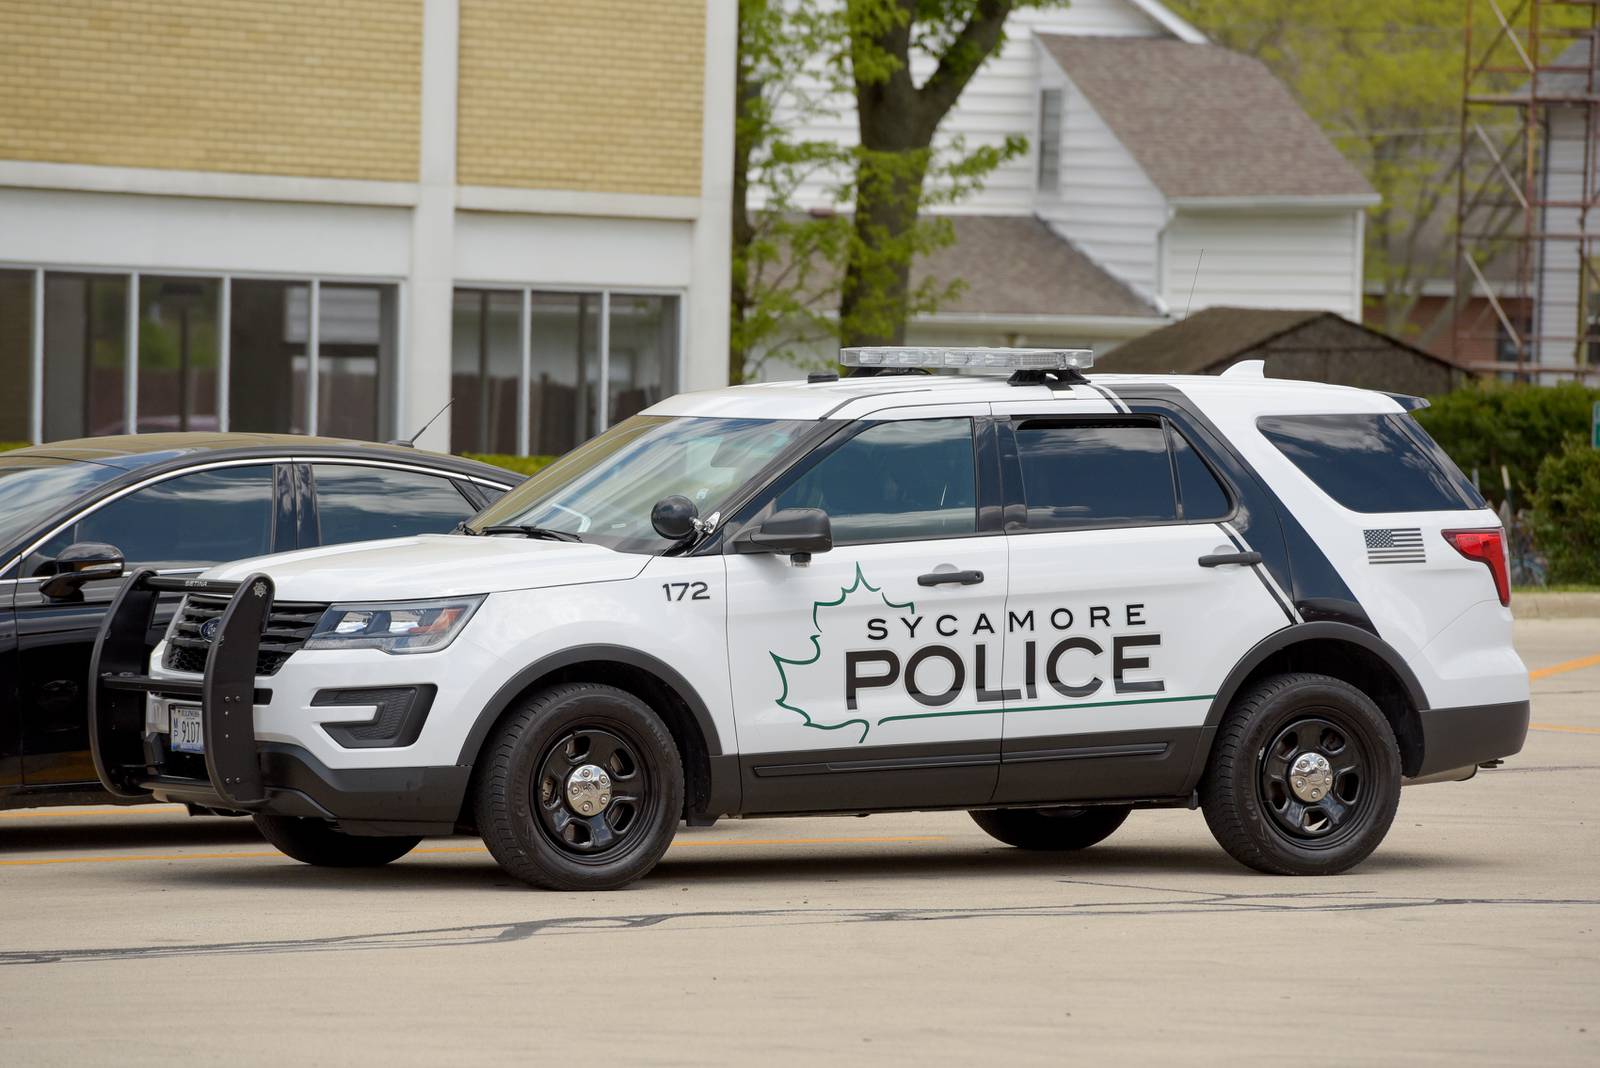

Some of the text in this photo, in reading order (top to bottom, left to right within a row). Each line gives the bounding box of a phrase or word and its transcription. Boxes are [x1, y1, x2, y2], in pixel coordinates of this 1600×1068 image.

[662, 581, 711, 602] 172
[867, 604, 1146, 641] SYCAMORE
[845, 634, 1165, 711] POLICE
[181, 720, 200, 743] 9107
